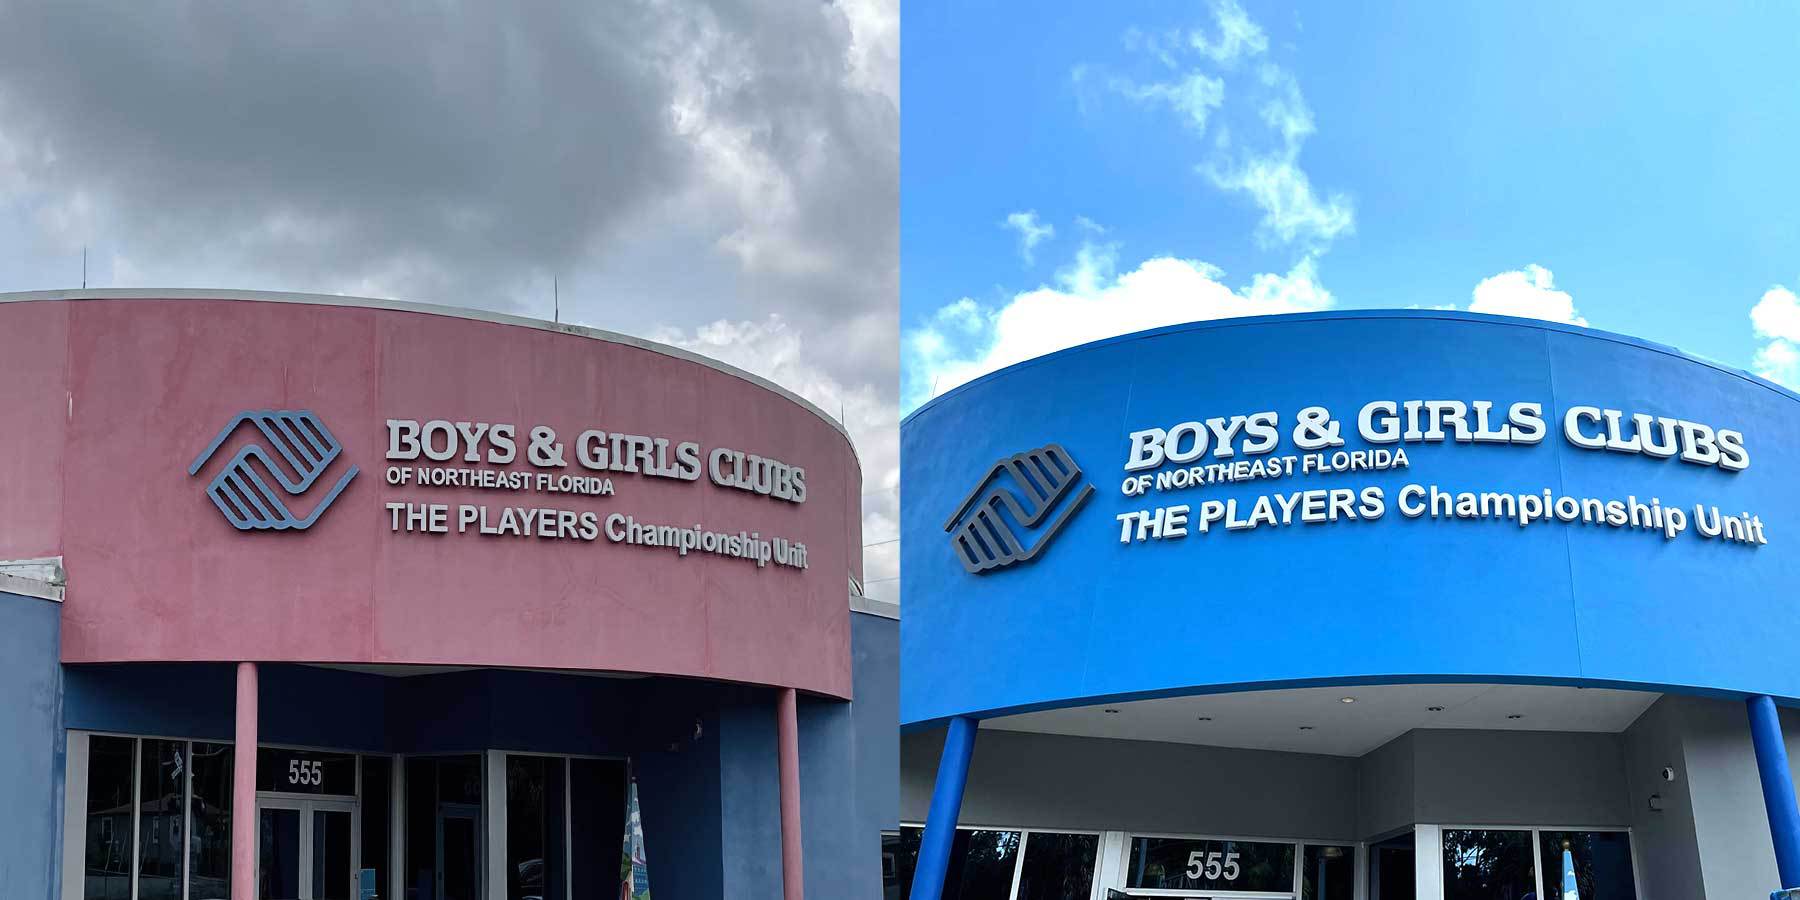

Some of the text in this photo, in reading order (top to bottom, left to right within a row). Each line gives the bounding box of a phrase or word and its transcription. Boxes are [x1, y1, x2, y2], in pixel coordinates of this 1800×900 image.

[386, 419, 807, 504] BOYS & GIRLS CLUBS
[1124, 400, 1750, 472] BOYS & GIRLS CLUBS
[386, 466, 615, 496] OF NORTHEAST FLORIDA
[1121, 448, 1409, 497] OF NORTHEAST FLORIDA
[386, 503, 809, 570] THE PLAYERS Championship Unit
[1116, 484, 1768, 546] THE PLAYERS Championship Unit
[288, 759, 322, 786] 555
[1187, 851, 1240, 880] 555
